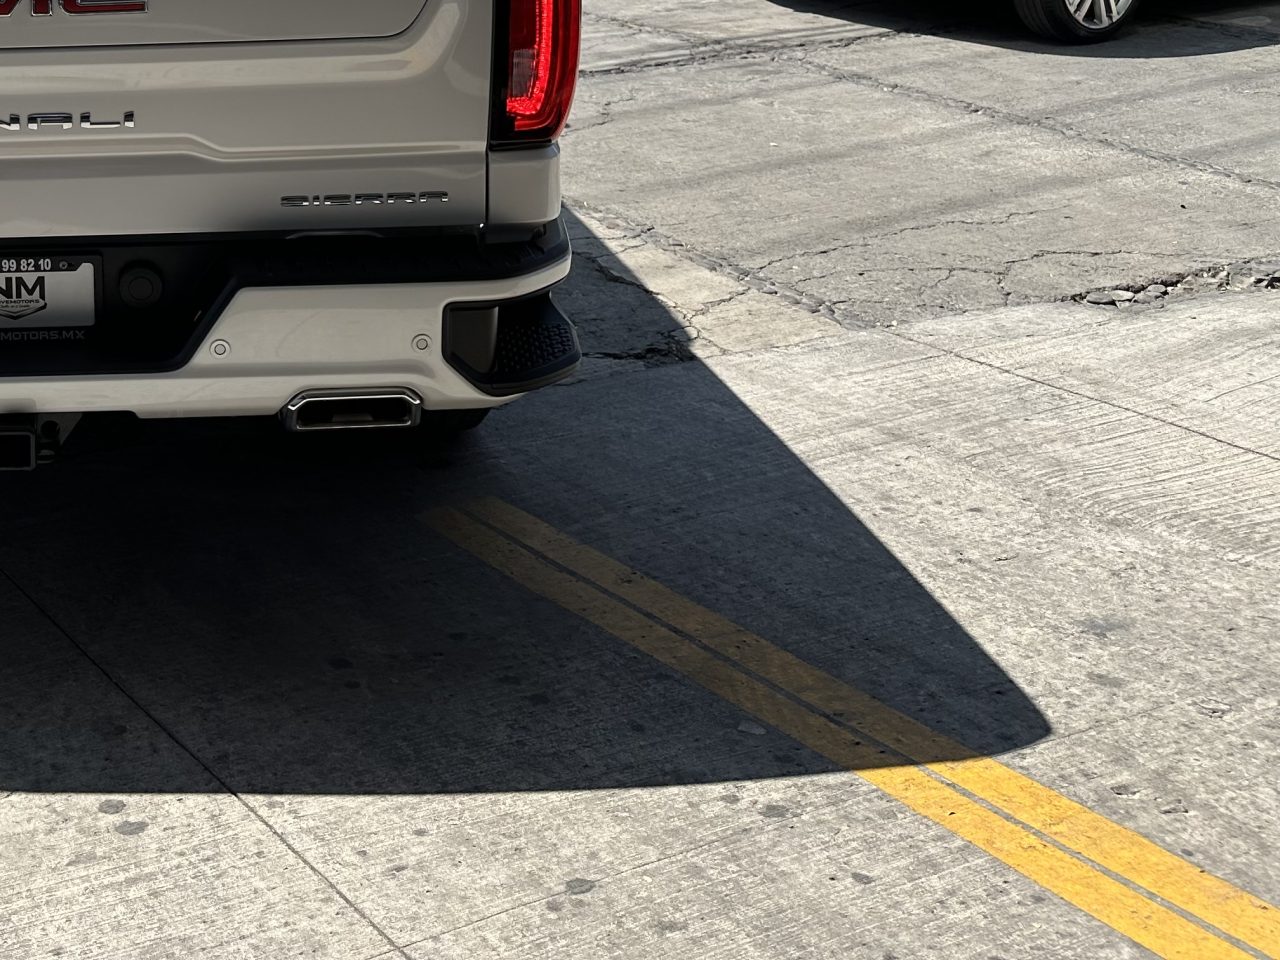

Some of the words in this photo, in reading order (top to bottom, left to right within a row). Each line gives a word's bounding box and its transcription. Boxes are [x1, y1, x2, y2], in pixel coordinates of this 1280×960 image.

[280, 190, 449, 208] SIERRA
[1, 259, 17, 272] 99
[20, 258, 35, 271] 82
[38, 258, 52, 271] 10
